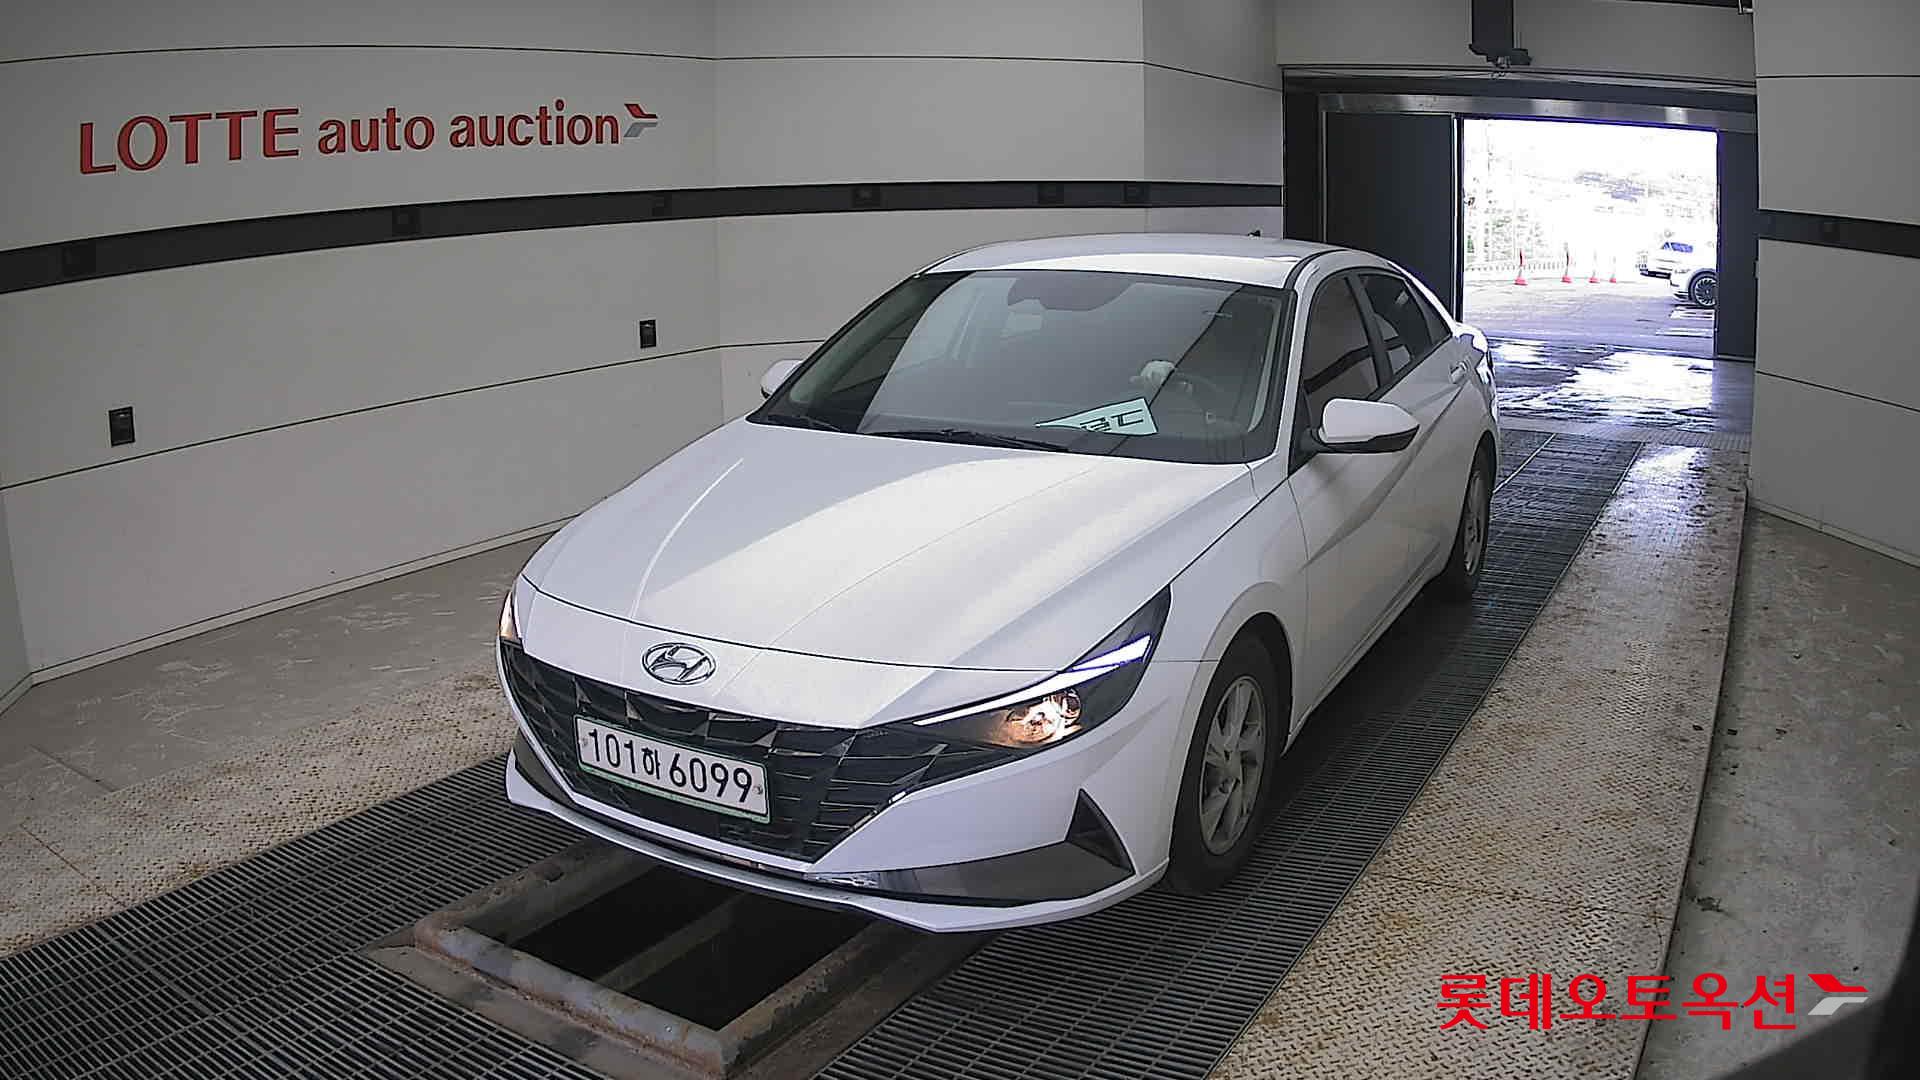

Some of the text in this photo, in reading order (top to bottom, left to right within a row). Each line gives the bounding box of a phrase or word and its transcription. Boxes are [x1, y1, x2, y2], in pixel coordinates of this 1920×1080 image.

[79, 99, 620, 174] LOTTE auto auction
